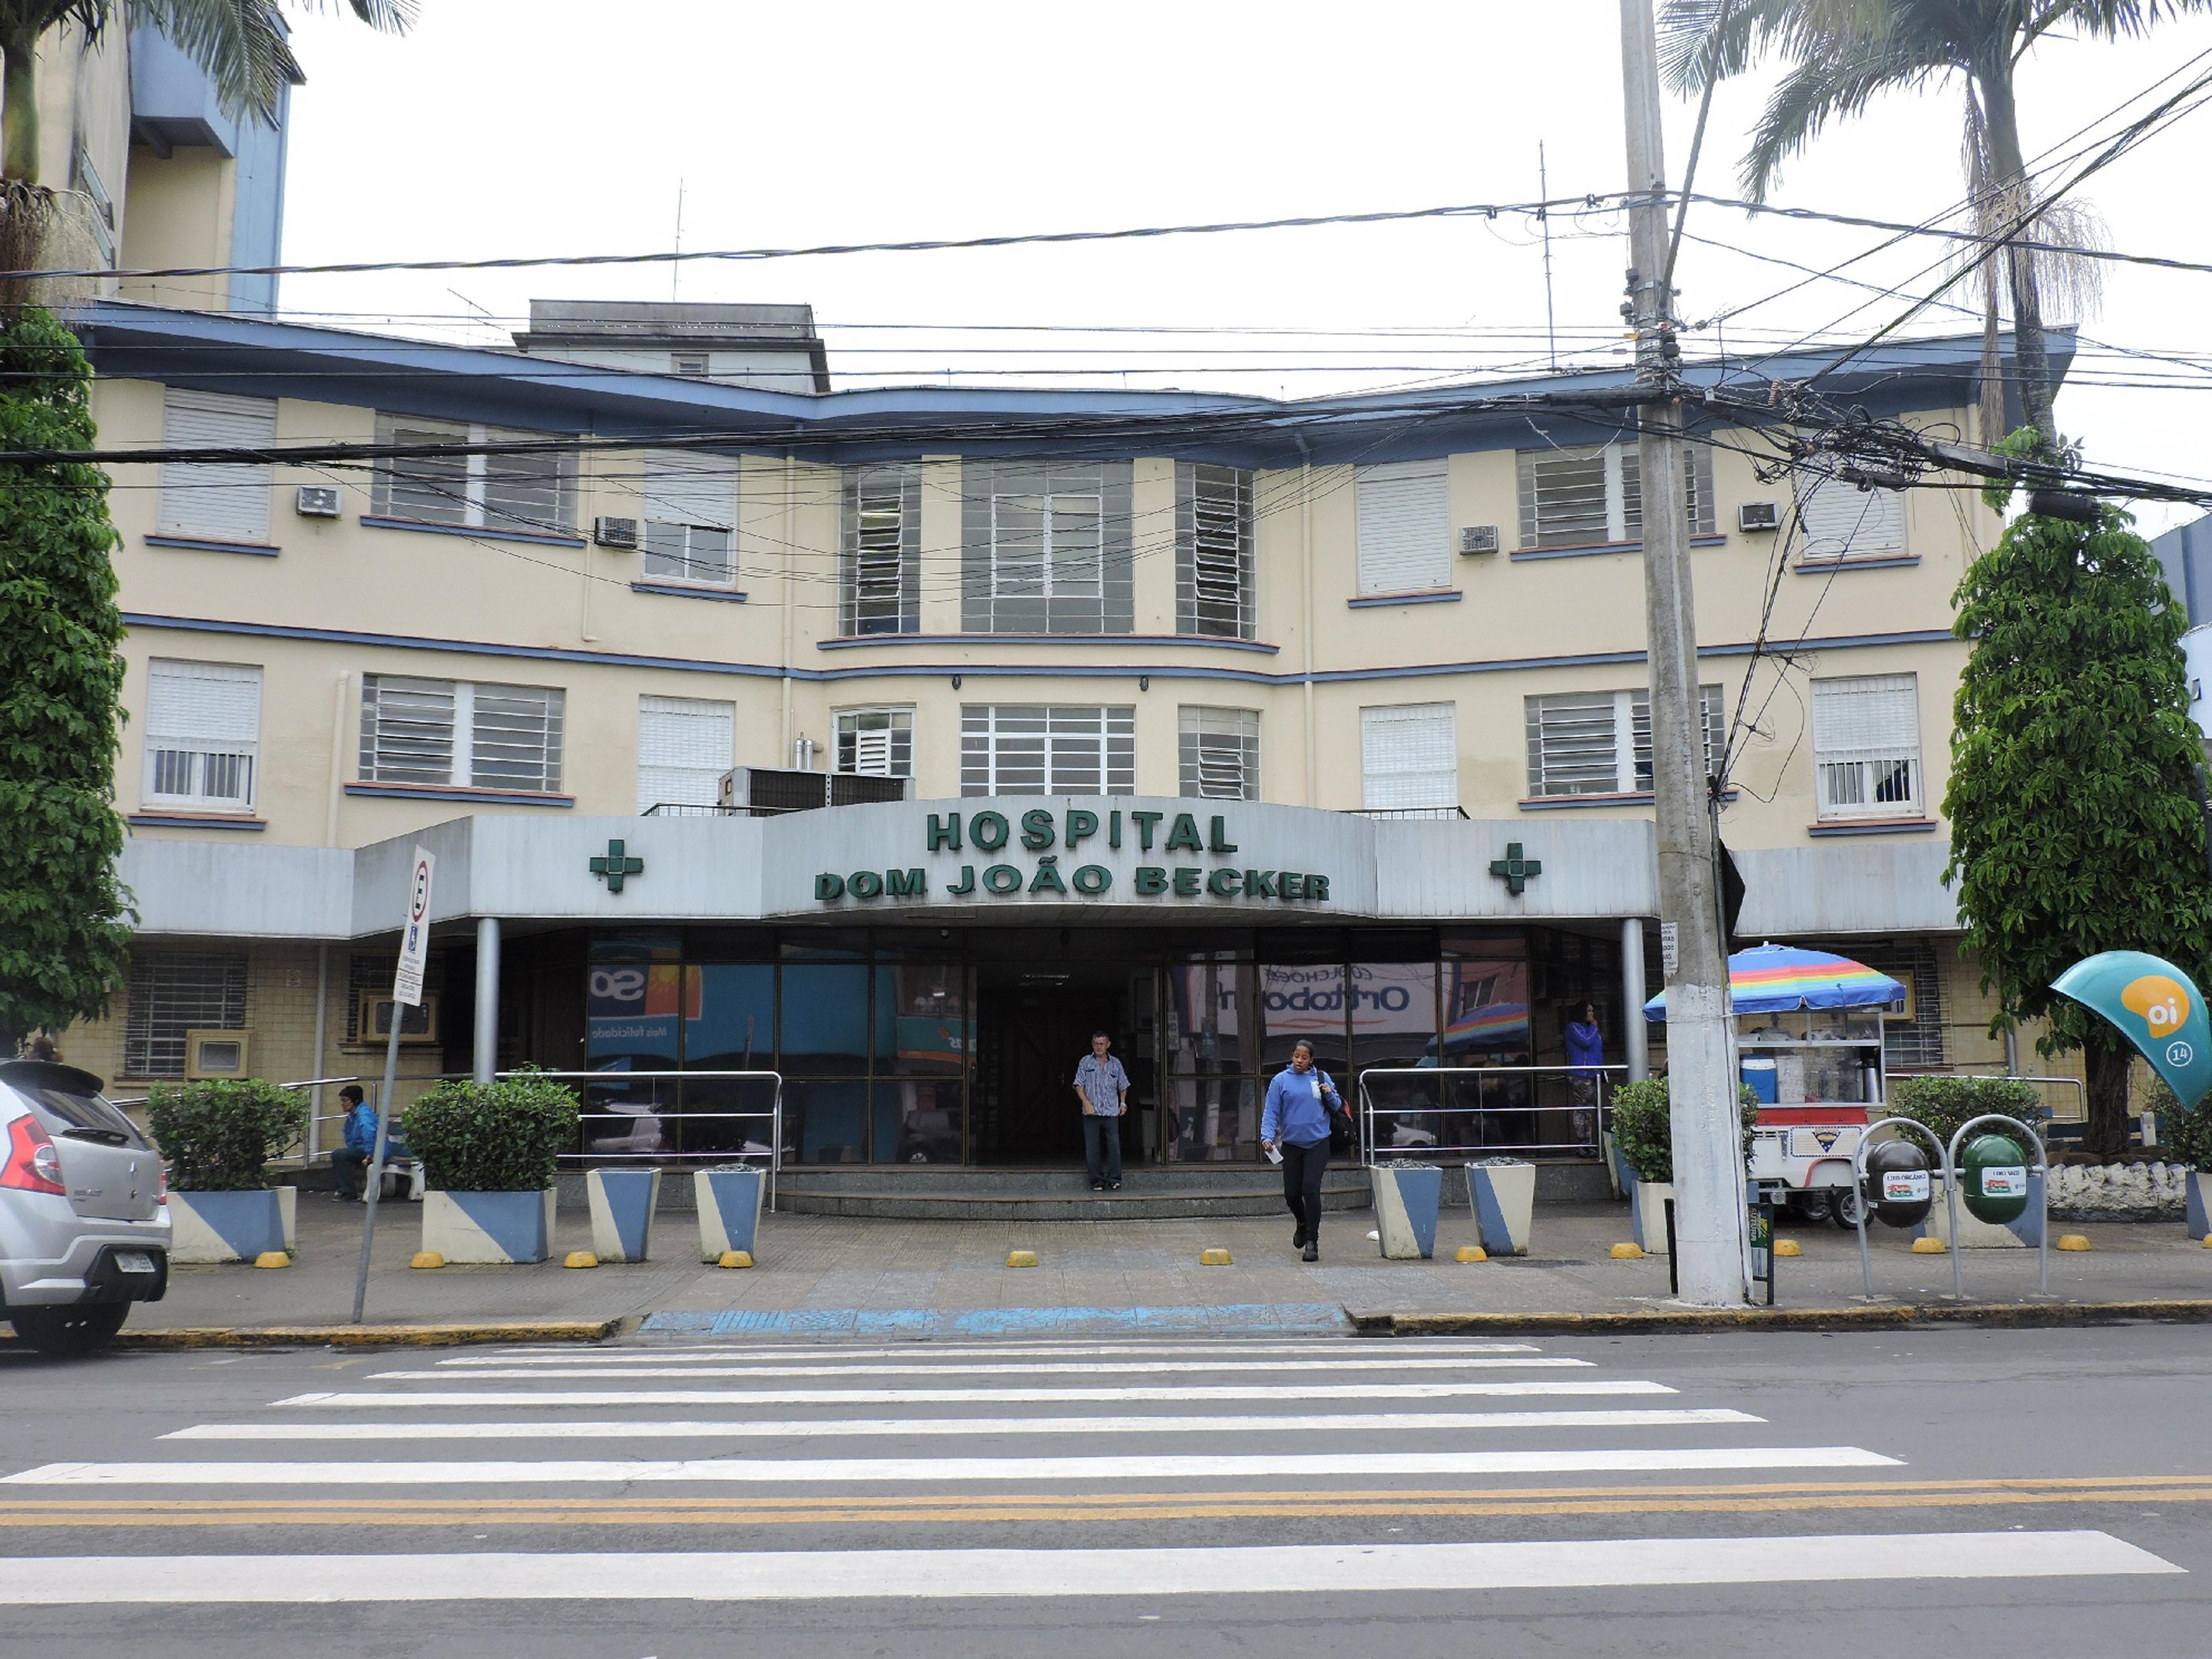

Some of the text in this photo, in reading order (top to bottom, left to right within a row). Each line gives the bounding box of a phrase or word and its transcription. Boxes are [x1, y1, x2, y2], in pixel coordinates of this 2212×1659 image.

[927, 809, 1238, 853] HOSPITAL
[815, 856, 1331, 901] DOM JOÃO BECKER
[2148, 997, 2177, 1025] oi
[2172, 1048, 2188, 1061] 14
